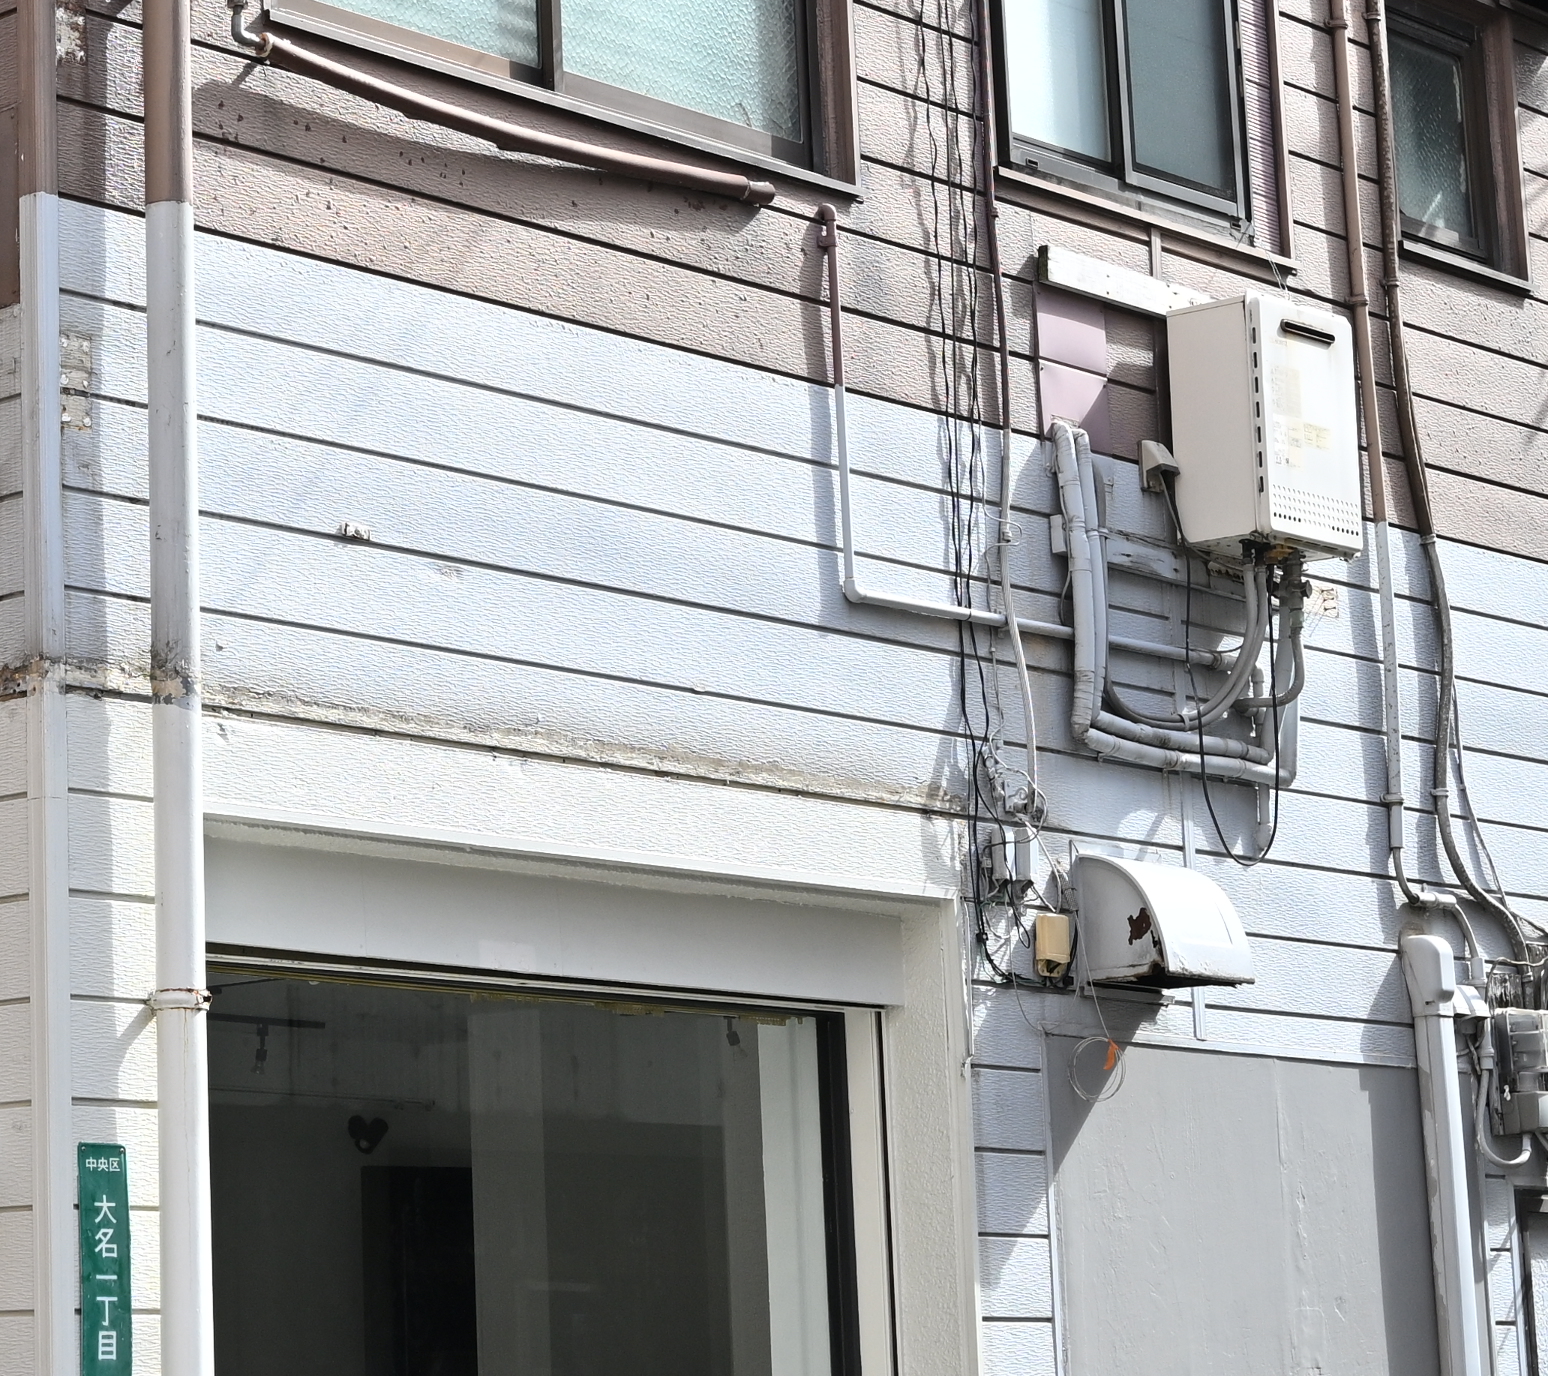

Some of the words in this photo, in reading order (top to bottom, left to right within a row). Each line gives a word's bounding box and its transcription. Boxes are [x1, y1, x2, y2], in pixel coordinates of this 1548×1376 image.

[85, 1156, 121, 1172] 中央区
[94, 1194, 118, 1360] 大名一丁目
